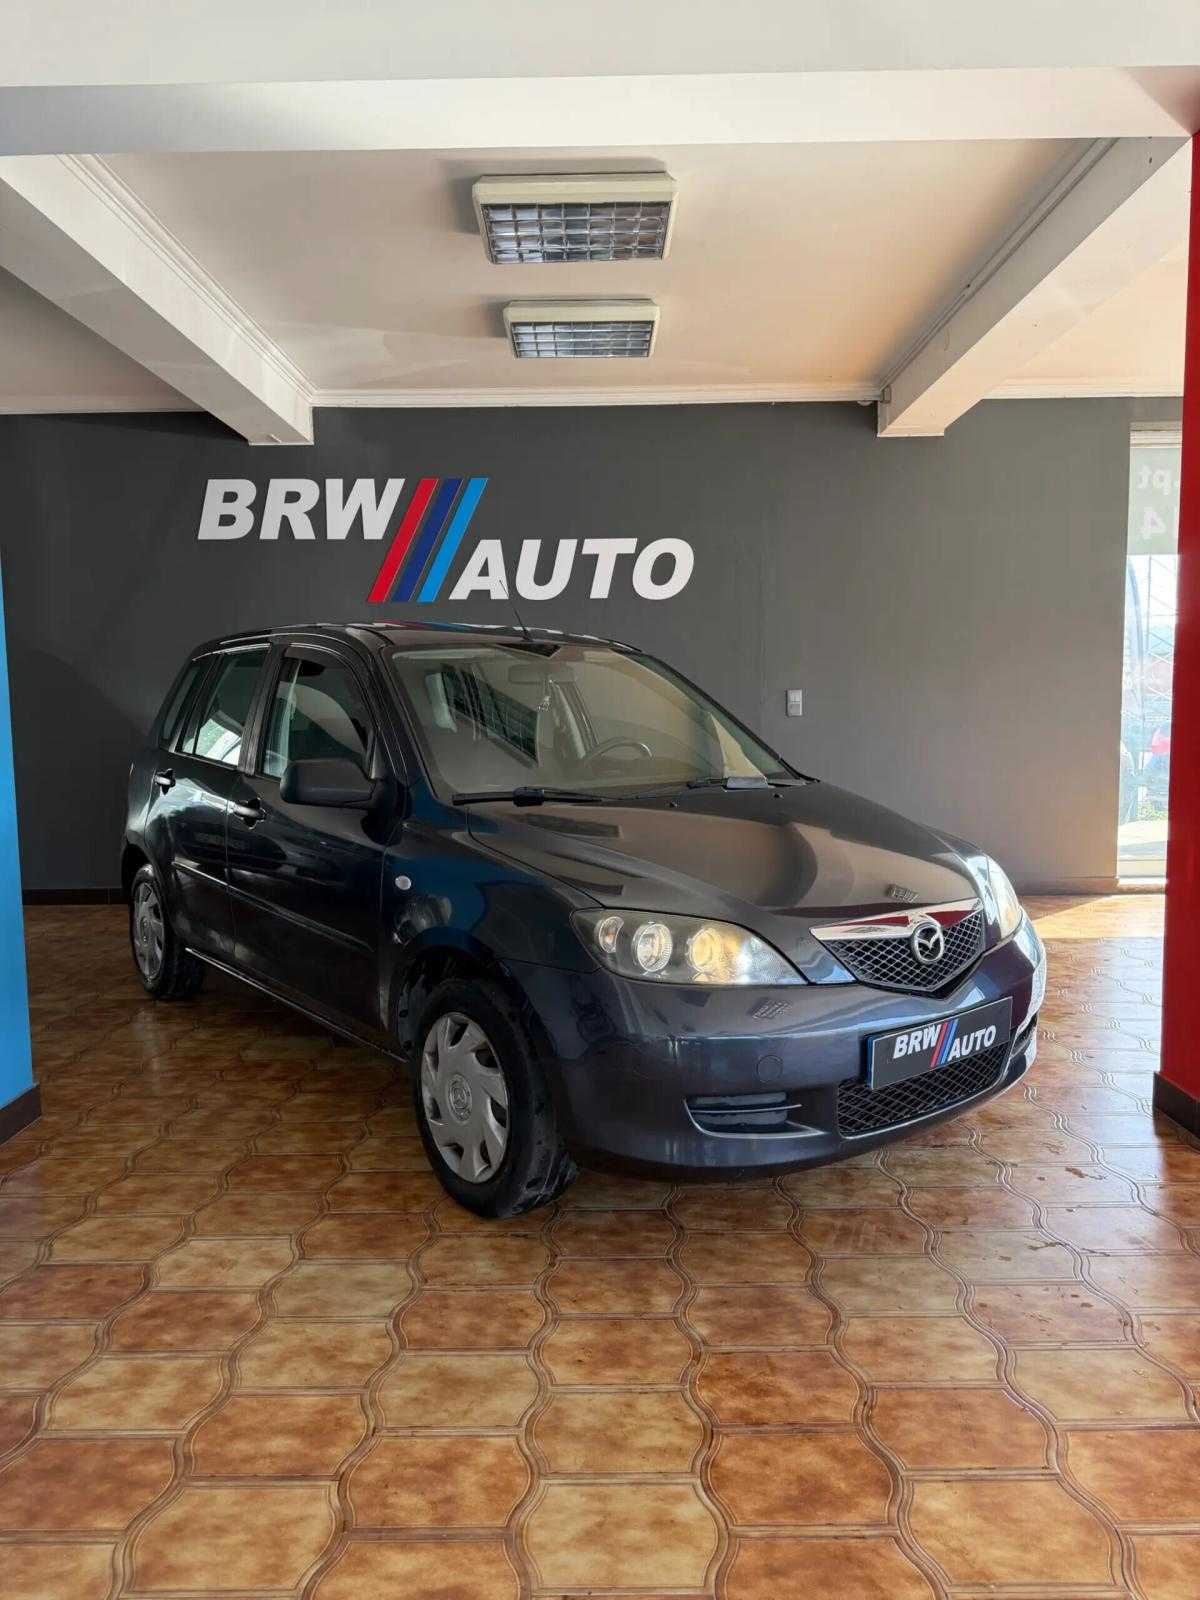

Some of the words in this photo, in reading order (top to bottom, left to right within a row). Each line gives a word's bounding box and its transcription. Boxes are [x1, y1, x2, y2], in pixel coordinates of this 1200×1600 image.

[198, 478, 405, 540] BRW
[449, 537, 695, 601] AUTO
[894, 1025, 941, 1059] BRW
[948, 1026, 997, 1062] AUTO
